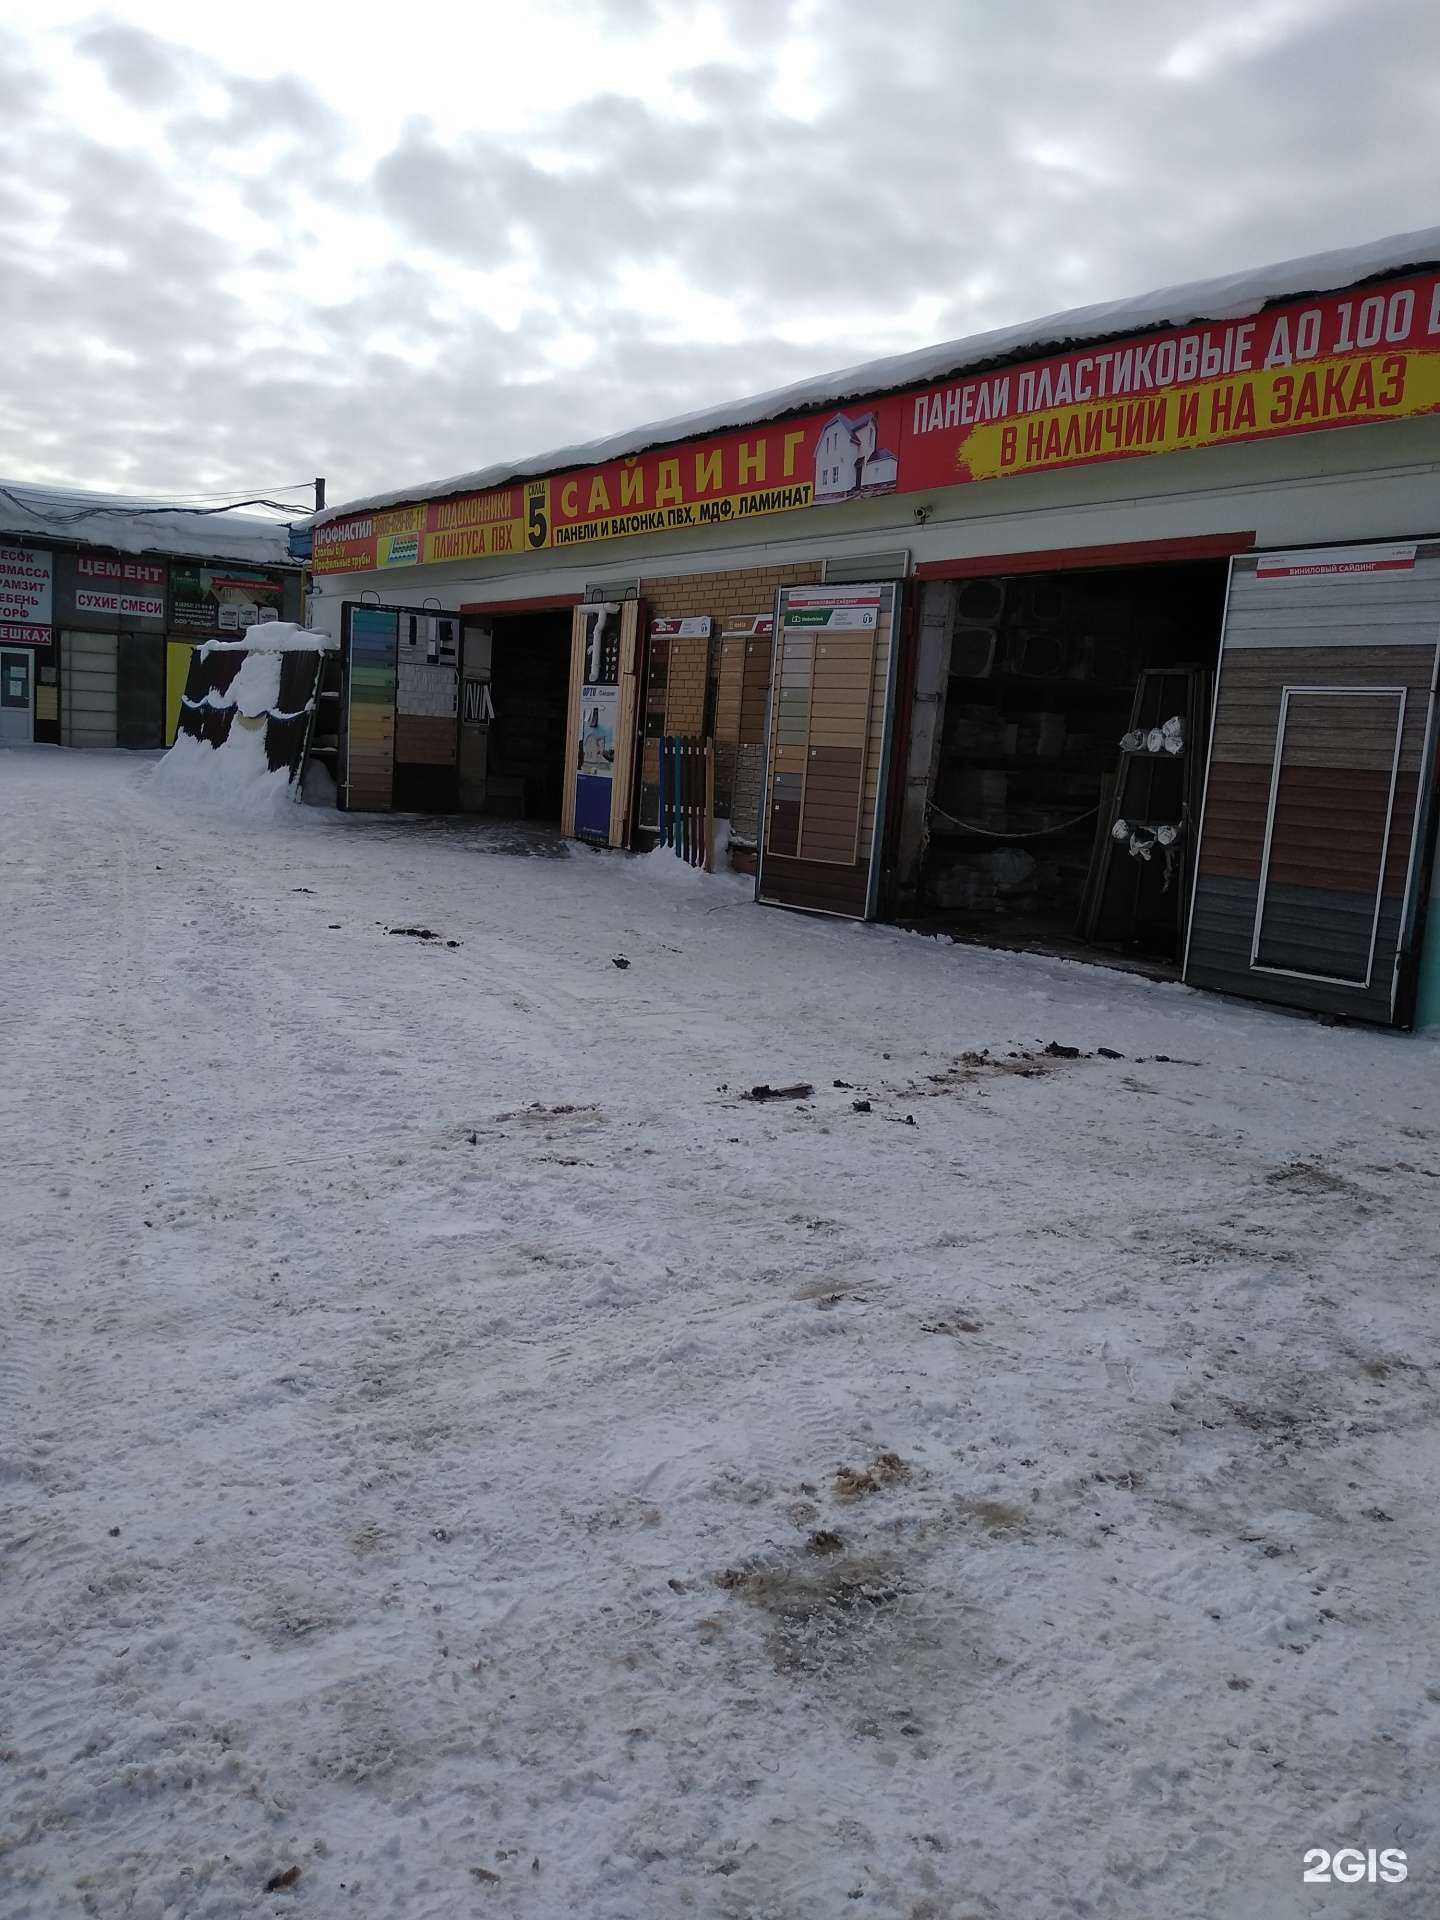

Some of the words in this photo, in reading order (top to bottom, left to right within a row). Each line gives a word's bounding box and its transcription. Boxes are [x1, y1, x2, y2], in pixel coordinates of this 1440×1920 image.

[913, 377, 1009, 435] ПАНЕЛИ
[1017, 322, 1256, 413] ПЛАСТИКОВЫЕ
[1263, 309, 1322, 372] ДО
[1333, 290, 1415, 354] 100
[1000, 426, 1017, 466] В
[1026, 398, 1168, 463] НАЛИЧИИ
[1177, 392, 1200, 438] И
[1210, 383, 1256, 433] НА
[1270, 355, 1407, 424] ЗАКАЗ
[561, 431, 805, 518] САЙДИНГ
[438, 491, 512, 529] ПОДОКОННИКИ
[528, 496, 547, 548] 5
[556, 522, 598, 544] ПАНЕЛИ
[601, 521, 609, 537] И
[612, 510, 665, 535] ВАГОНКА
[668, 508, 696, 526] ПВХ,
[700, 499, 735, 522] МДФ,
[739, 485, 811, 515] ЛАМИНАТ
[315, 519, 373, 545] ПРОФНАСТИЛ
[433, 529, 486, 560] ПЛИНТУСА
[491, 525, 513, 552] ПВХ
[78, 559, 163, 582] ЦЕМЕНТ
[1289, 564, 1337, 576] ВИНИЛОВЫЙ
[1339, 563, 1377, 573] САЙДИНГ
[78, 594, 118, 609] СУХИЕ
[120, 601, 162, 614] СМЕСИ
